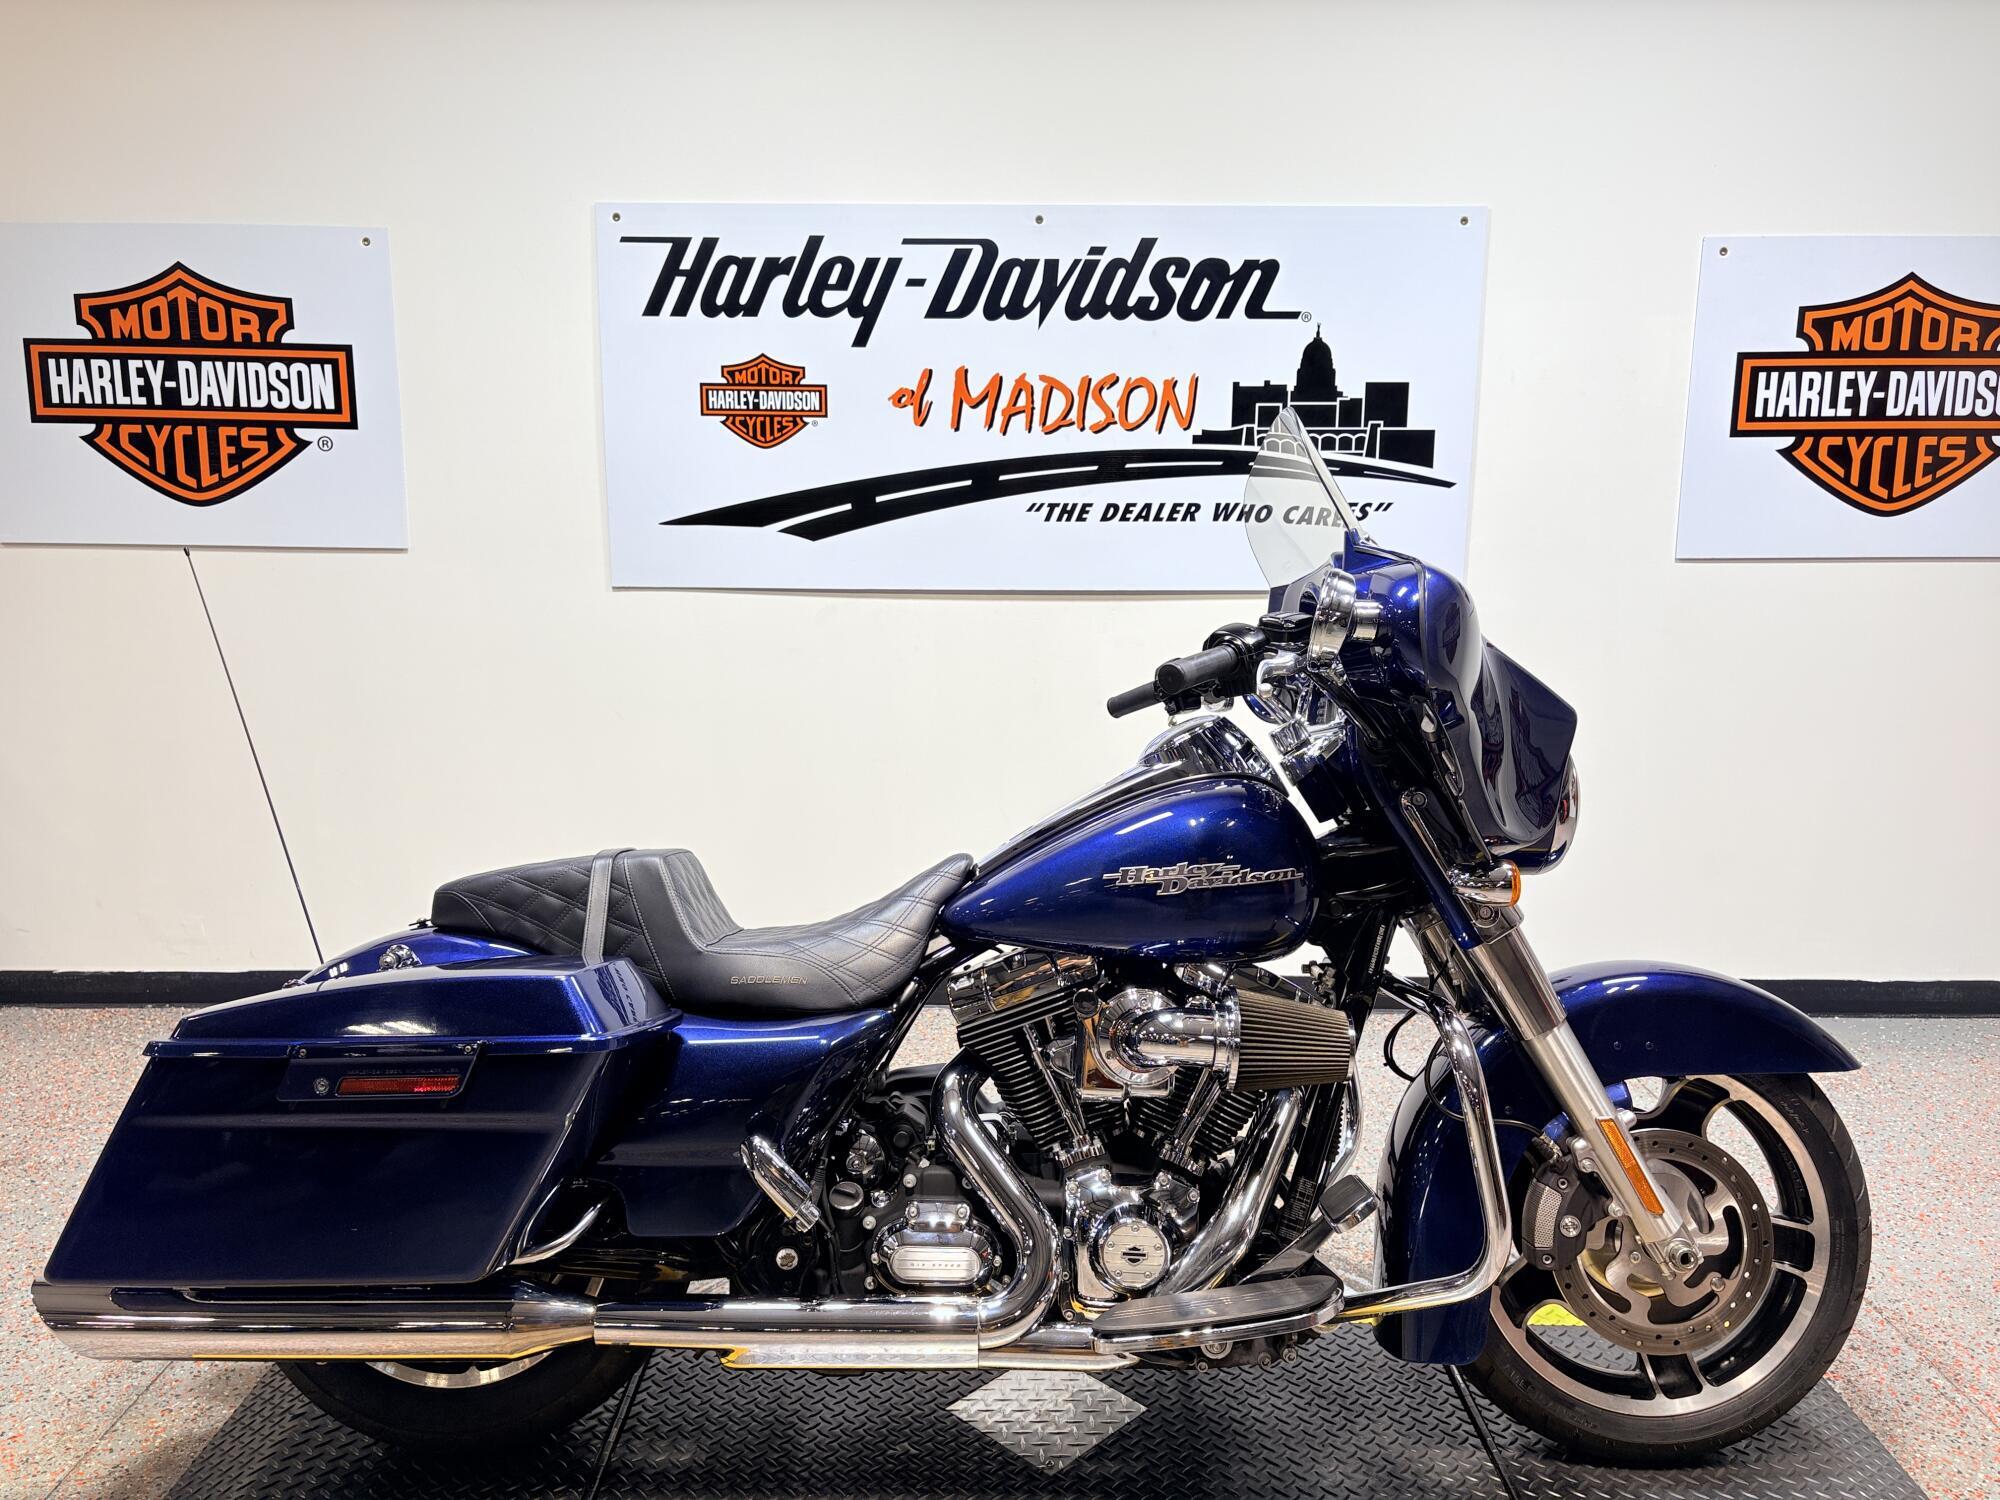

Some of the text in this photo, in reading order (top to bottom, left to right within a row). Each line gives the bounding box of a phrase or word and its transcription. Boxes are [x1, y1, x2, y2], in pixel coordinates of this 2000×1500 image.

[110, 285, 261, 343] MOTOR
[619, 235, 1302, 348] Harley-Davidson
[1830, 296, 1981, 352] MOTOR
[47, 358, 335, 410] HARLEY-DAVIDSON
[734, 362, 793, 385] MOTOR
[1754, 370, 2000, 417] HARLEY-DAVIDS
[708, 390, 820, 411] HARLEY-DAVIDSON
[950, 365, 1199, 437] MADISON
[735, 416, 794, 442] CYCLES
[119, 424, 269, 489] CYCLES
[1818, 436, 1967, 499] CYCLES
[1099, 502, 1202, 523] DEALER
[1212, 502, 1274, 524] WHO
[730, 975, 808, 985] SADDLEMEN
